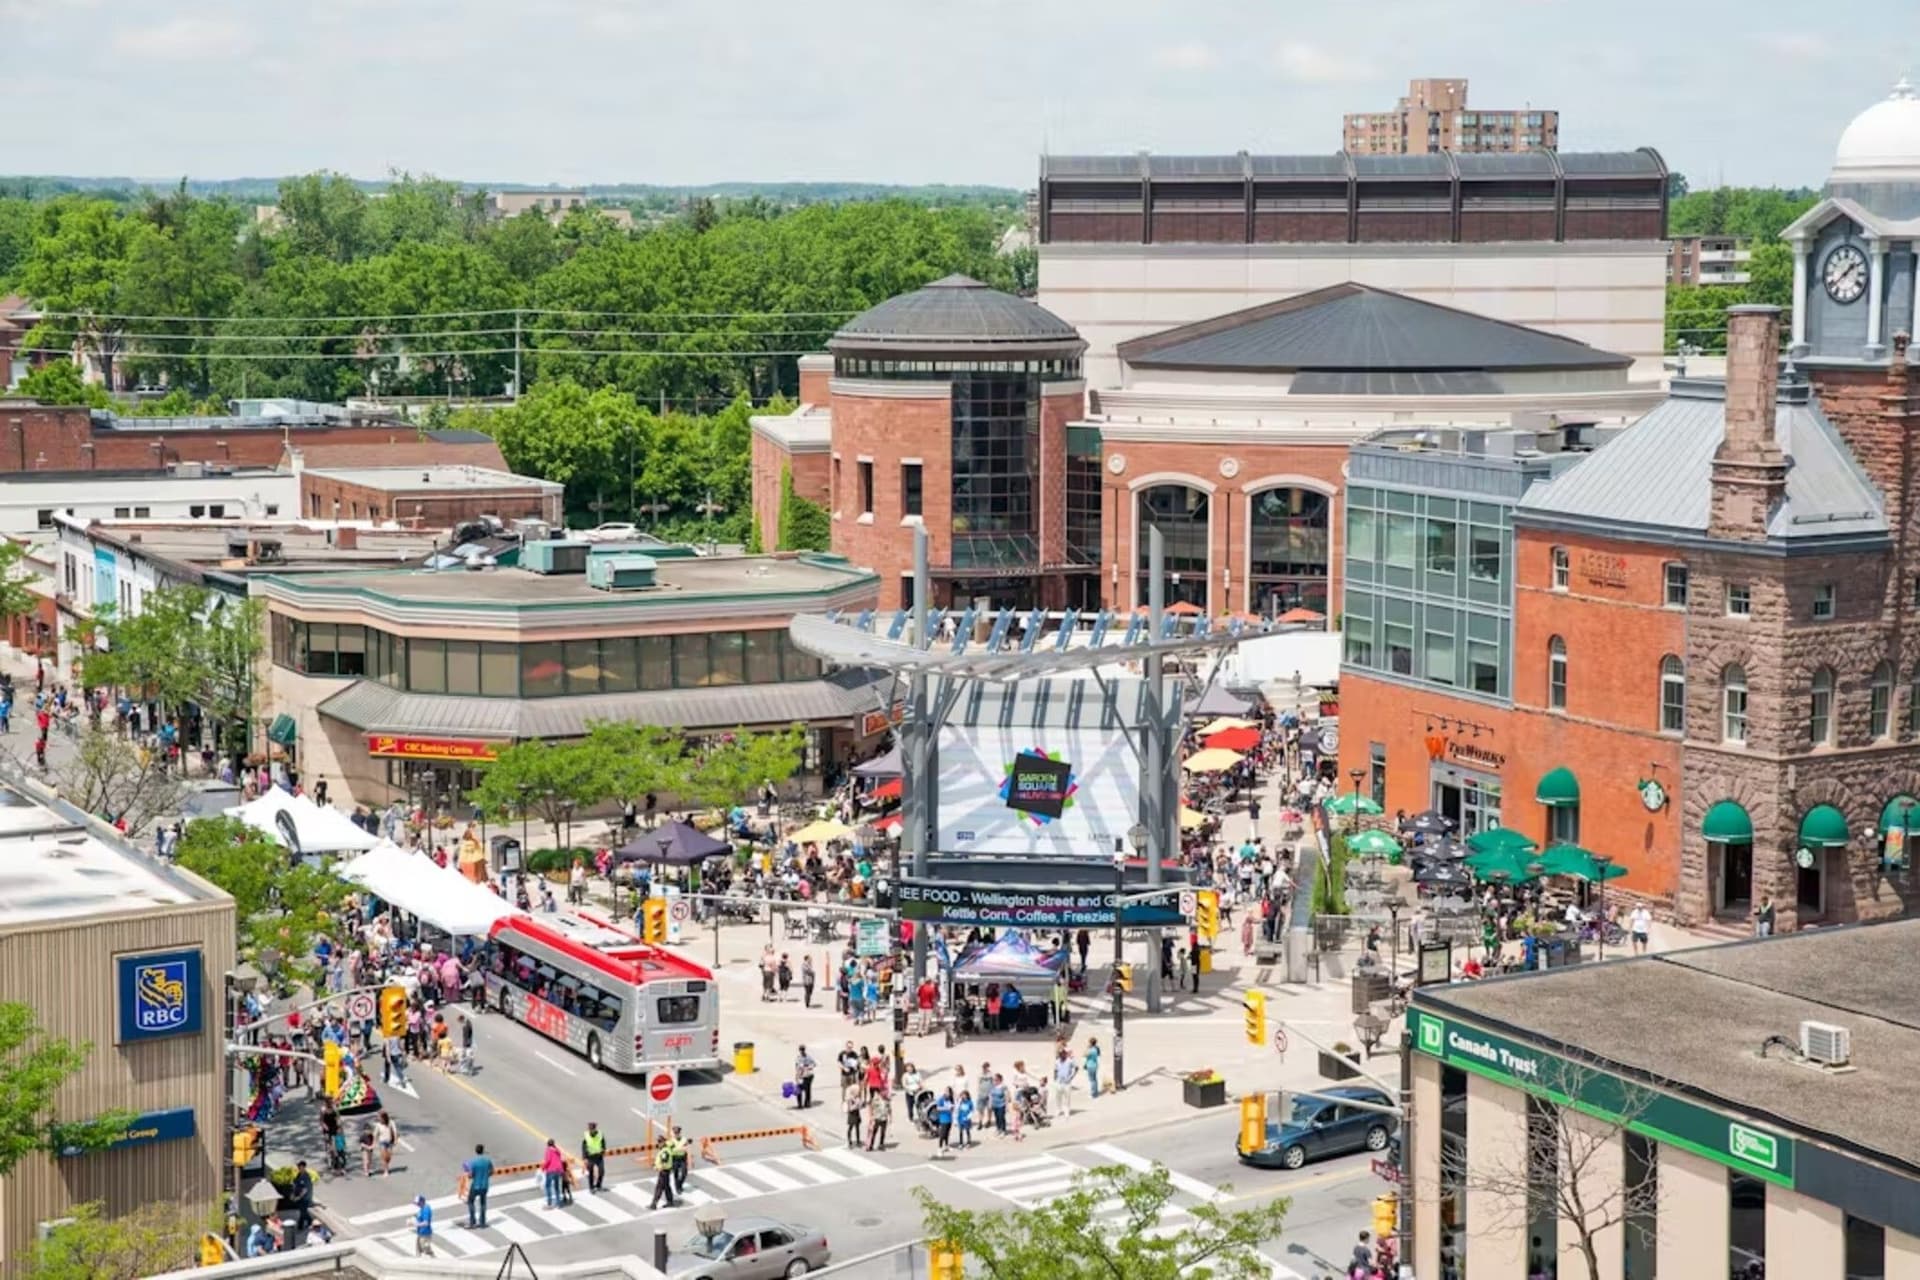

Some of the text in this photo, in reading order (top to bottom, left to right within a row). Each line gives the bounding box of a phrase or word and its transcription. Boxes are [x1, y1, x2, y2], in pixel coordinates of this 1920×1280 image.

[1018, 773, 1057, 782] GARDEN
[1018, 782, 1057, 791] SQUARE
[923, 888, 960, 902] FOOD
[971, 892, 1034, 908] Wellington
[1037, 894, 1071, 907] Street
[1077, 895, 1101, 907] and
[942, 906, 1116, 924] Kettle Corn, Coffee, Freezies
[143, 1007, 182, 1026] RBC
[1421, 1021, 1441, 1048] TD
[1448, 1031, 1538, 1077] Canada Trust
[128, 1128, 158, 1139] Group
